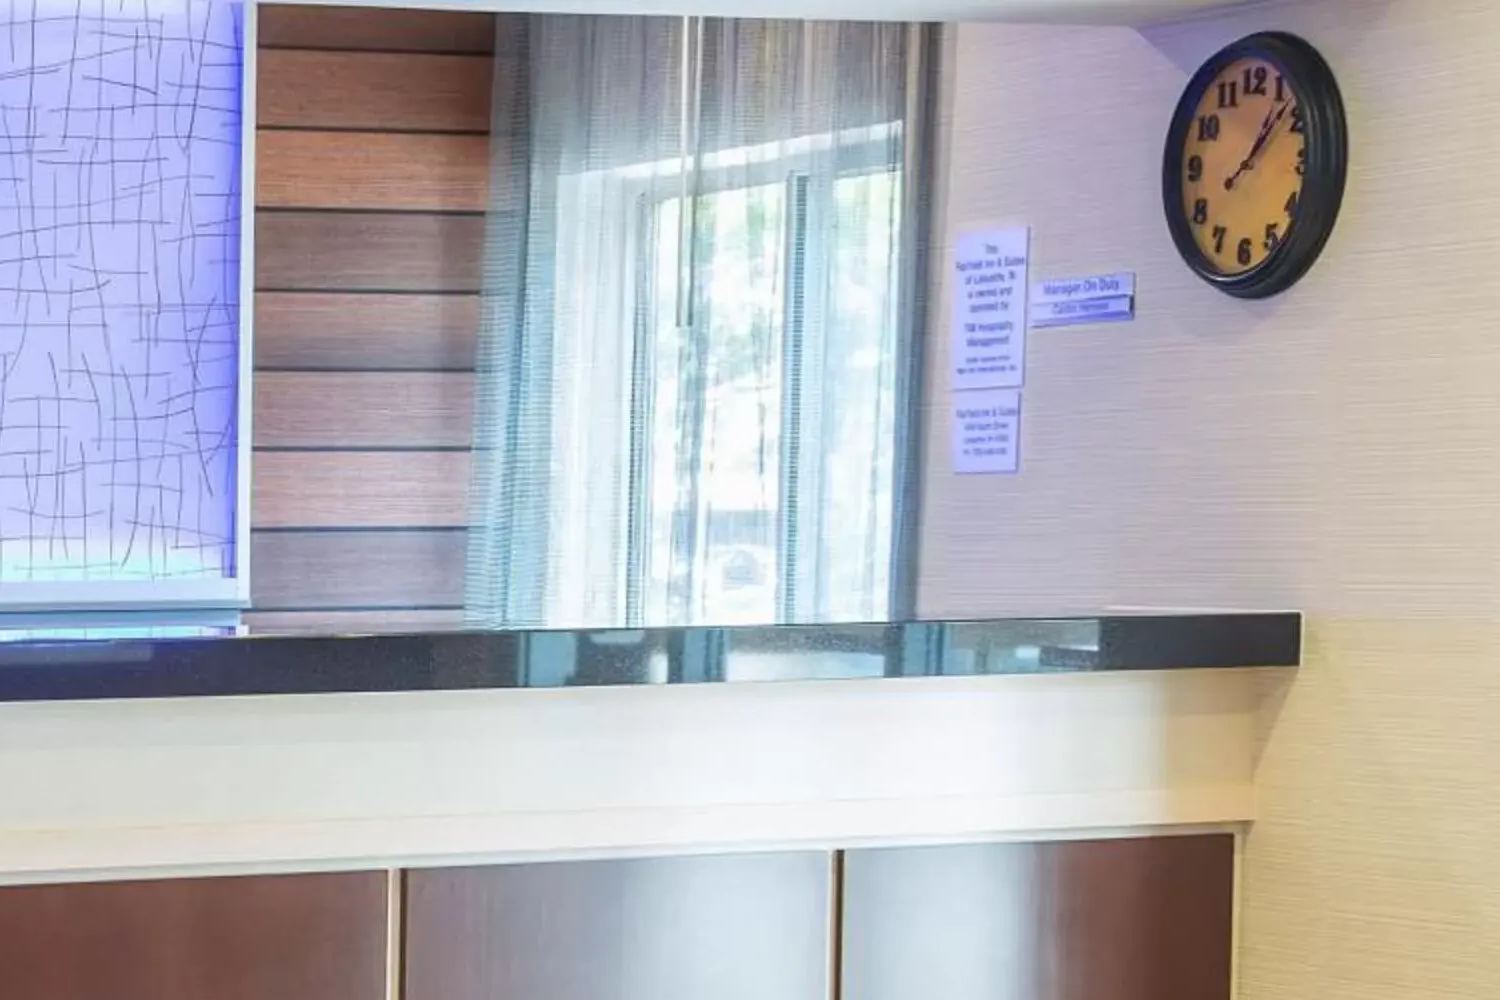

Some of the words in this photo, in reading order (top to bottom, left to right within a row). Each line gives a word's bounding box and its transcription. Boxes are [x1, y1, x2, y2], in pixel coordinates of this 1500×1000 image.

[1243, 67, 1266, 95] 12
[1274, 75, 1286, 101] 1
[1217, 81, 1238, 109] 11
[1197, 115, 1220, 141] 10
[1289, 106, 1303, 132] 2
[1188, 155, 1202, 181] 9
[1193, 198, 1207, 224] 8
[1212, 225, 1226, 252] 7
[1264, 223, 1279, 249] 5
[1237, 238, 1252, 265] 6
[1083, 279, 1097, 291] On
